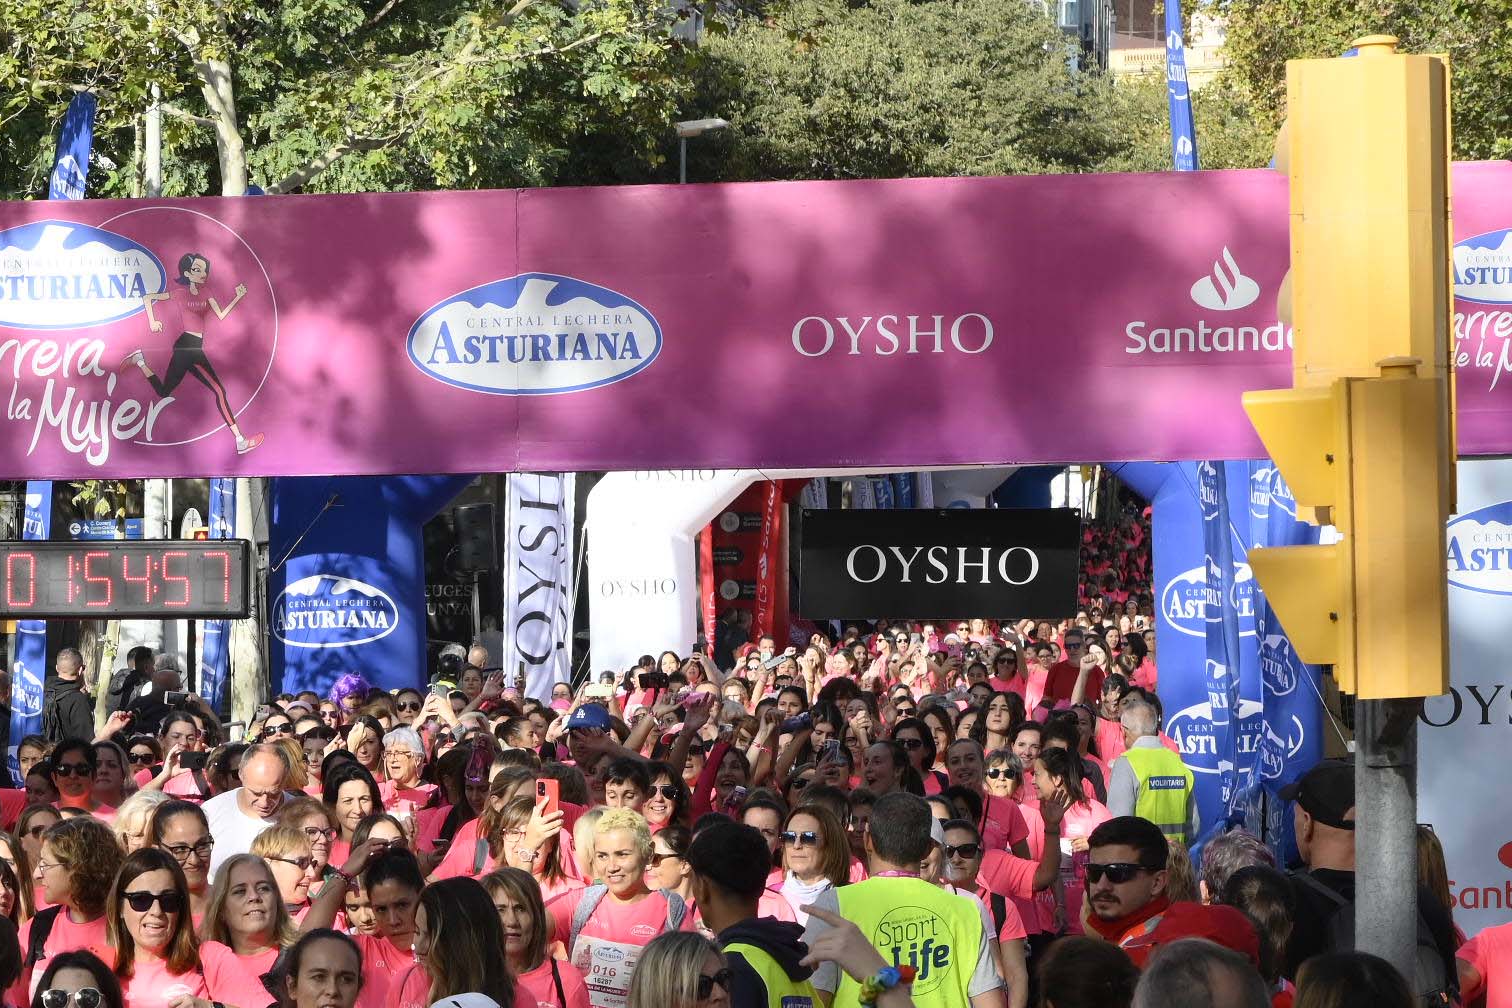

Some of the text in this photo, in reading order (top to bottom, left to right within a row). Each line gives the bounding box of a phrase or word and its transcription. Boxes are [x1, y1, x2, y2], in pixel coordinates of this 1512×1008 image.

[466, 314, 633, 328] CENTRAL LECHERA
[792, 312, 994, 356] OYSHO
[427, 320, 642, 364] ASTURIANA
[8, 381, 32, 420] la
[27, 371, 175, 466] Mujer
[8, 552, 228, 606] 01:54:57
[847, 545, 1039, 585] OYSHO
[289, 600, 331, 608] CENTRAL
[601, 578, 677, 598] OYSHO
[276, 603, 389, 631] ASTURIANA
[880, 914, 938, 949] Sport
[593, 965, 616, 977] 016
[891, 938, 950, 980] Life
